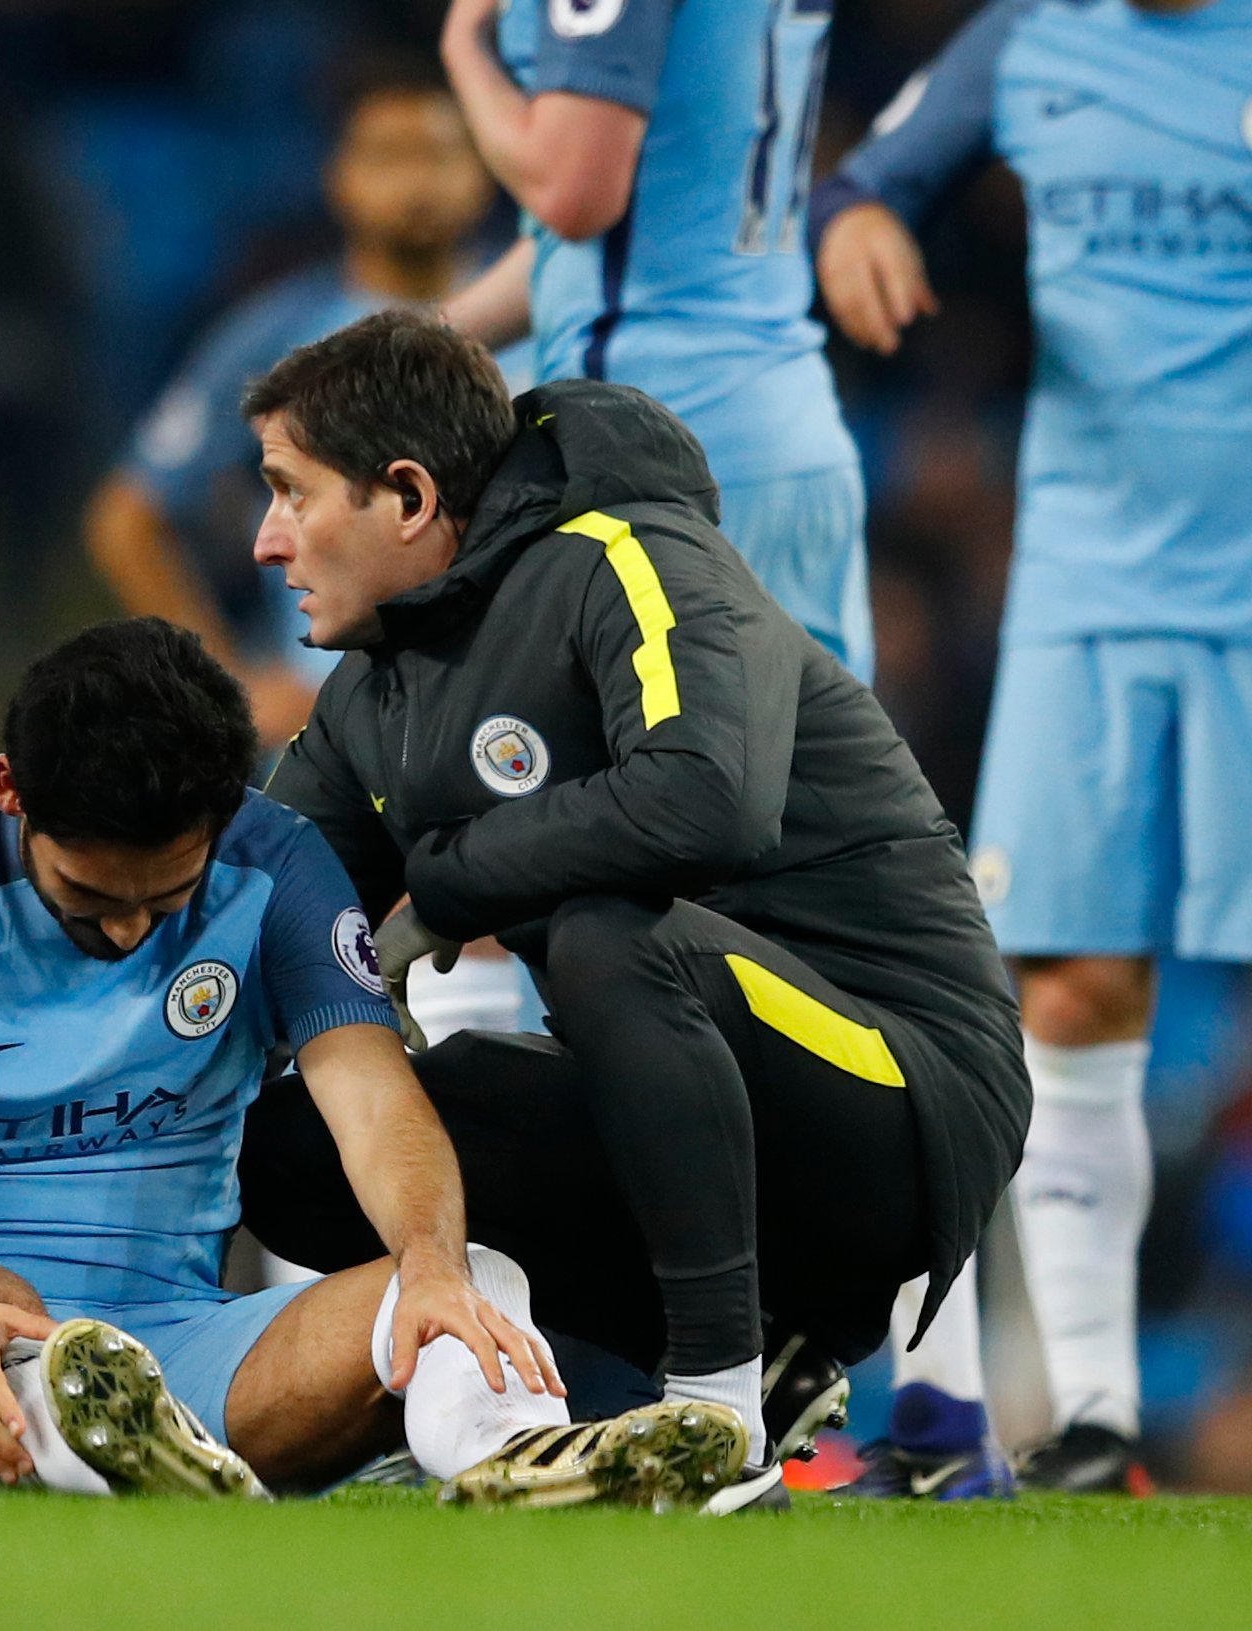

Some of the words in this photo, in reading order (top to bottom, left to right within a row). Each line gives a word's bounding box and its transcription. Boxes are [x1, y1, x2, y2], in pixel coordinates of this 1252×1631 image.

[476, 720, 529, 759] MANCHESTER
[518, 775, 539, 791] CITY
[171, 966, 230, 1002] MANCHESTER
[195, 1020, 217, 1034] CITY
